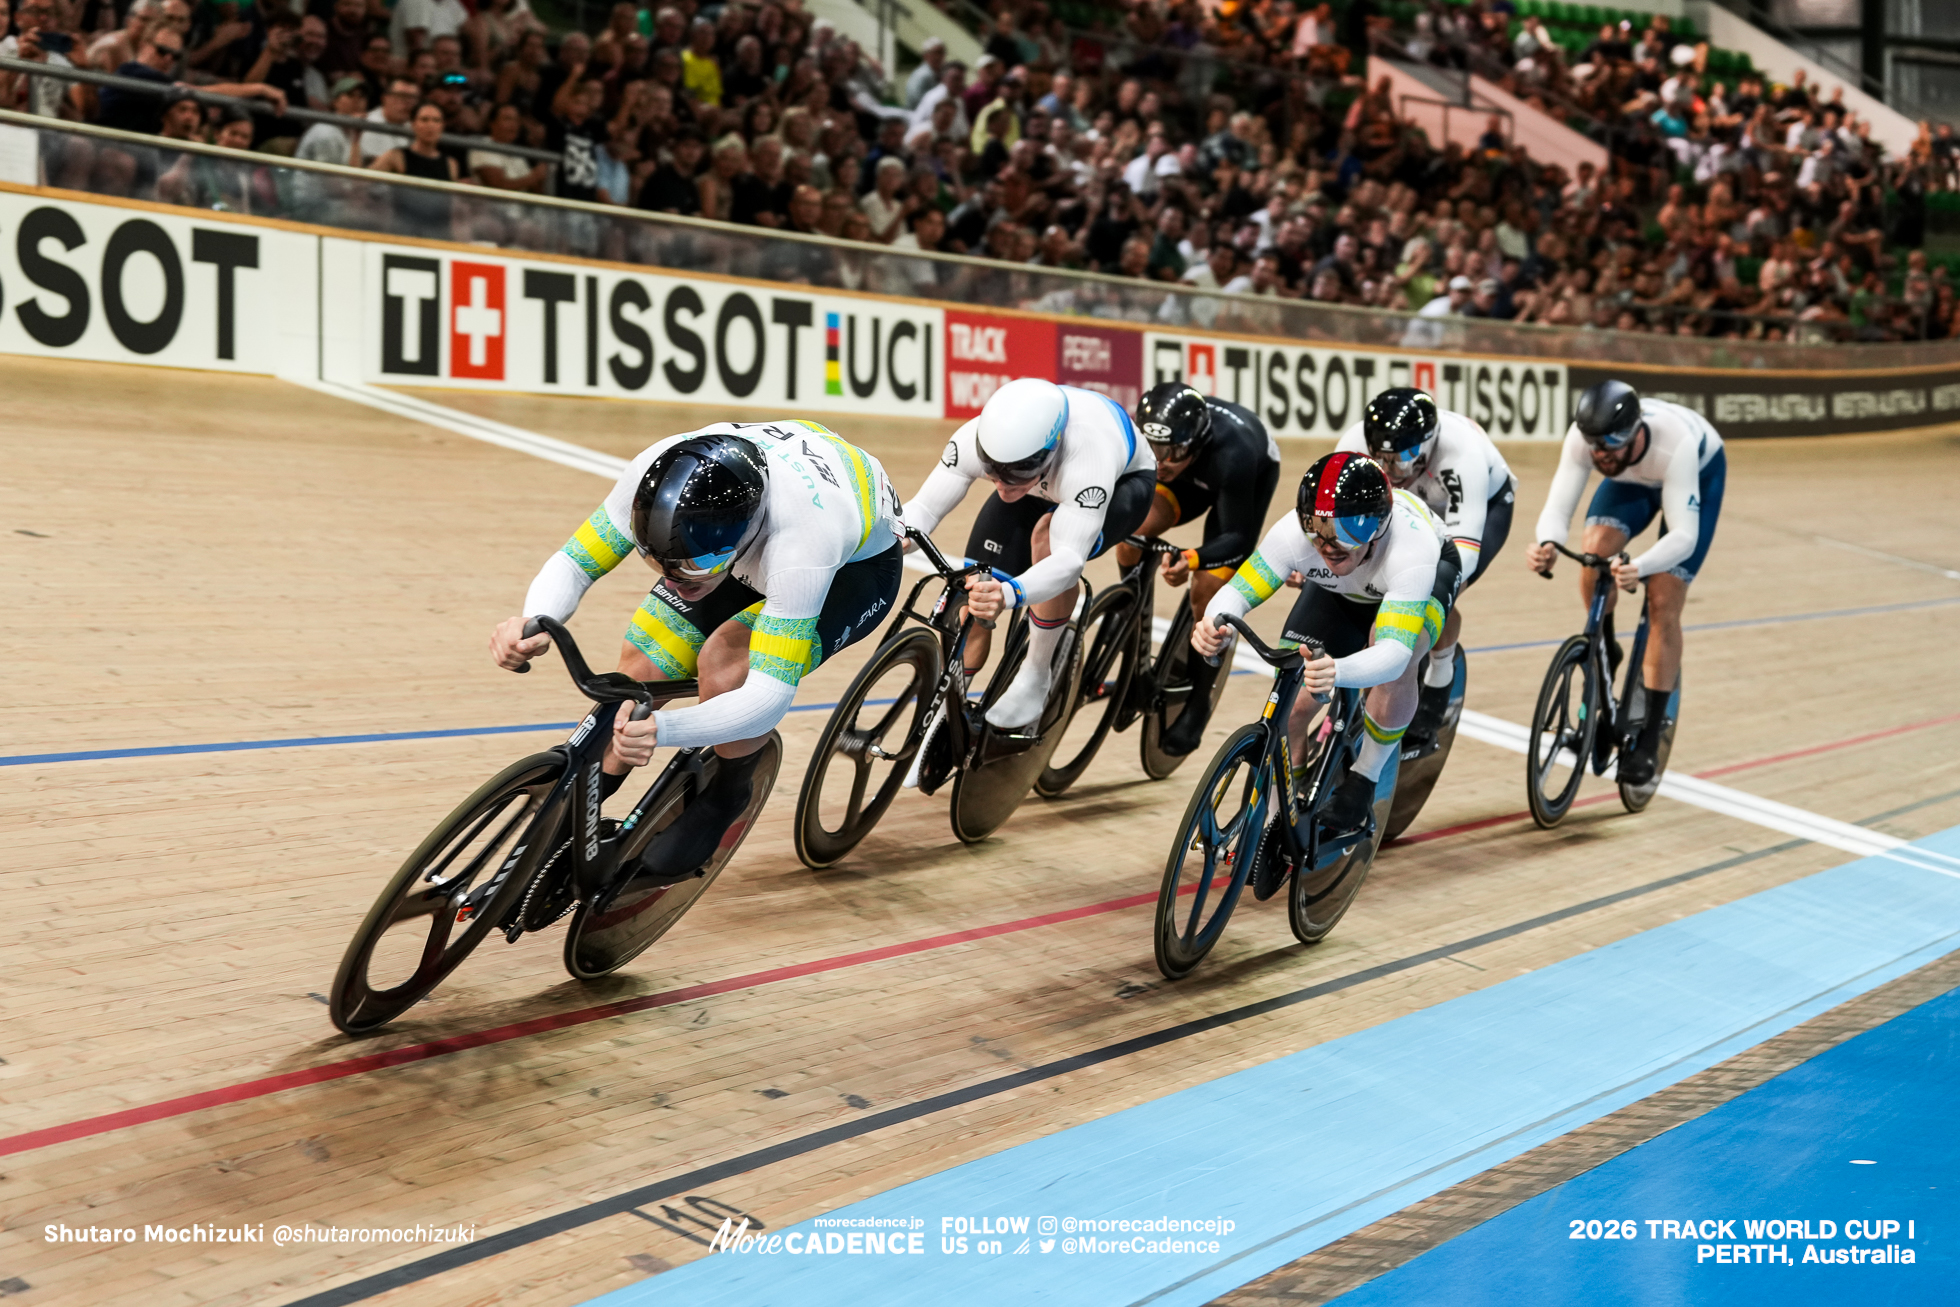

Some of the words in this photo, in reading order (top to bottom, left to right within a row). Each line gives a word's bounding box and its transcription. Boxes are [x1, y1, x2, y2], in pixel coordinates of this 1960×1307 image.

[0, 206, 259, 361] SOT
[523, 269, 813, 400] TISSOT
[847, 314, 933, 402] UCI
[950, 323, 1006, 363] TRACK
[1225, 346, 1375, 432] TISSOT
[1443, 362, 1559, 435] TISSOT
[1440, 468, 1464, 513] KTM
[653, 584, 693, 613] Santini
[918, 659, 960, 736] OTUS
[585, 761, 601, 839] ARGON
[585, 834, 600, 862] 18
